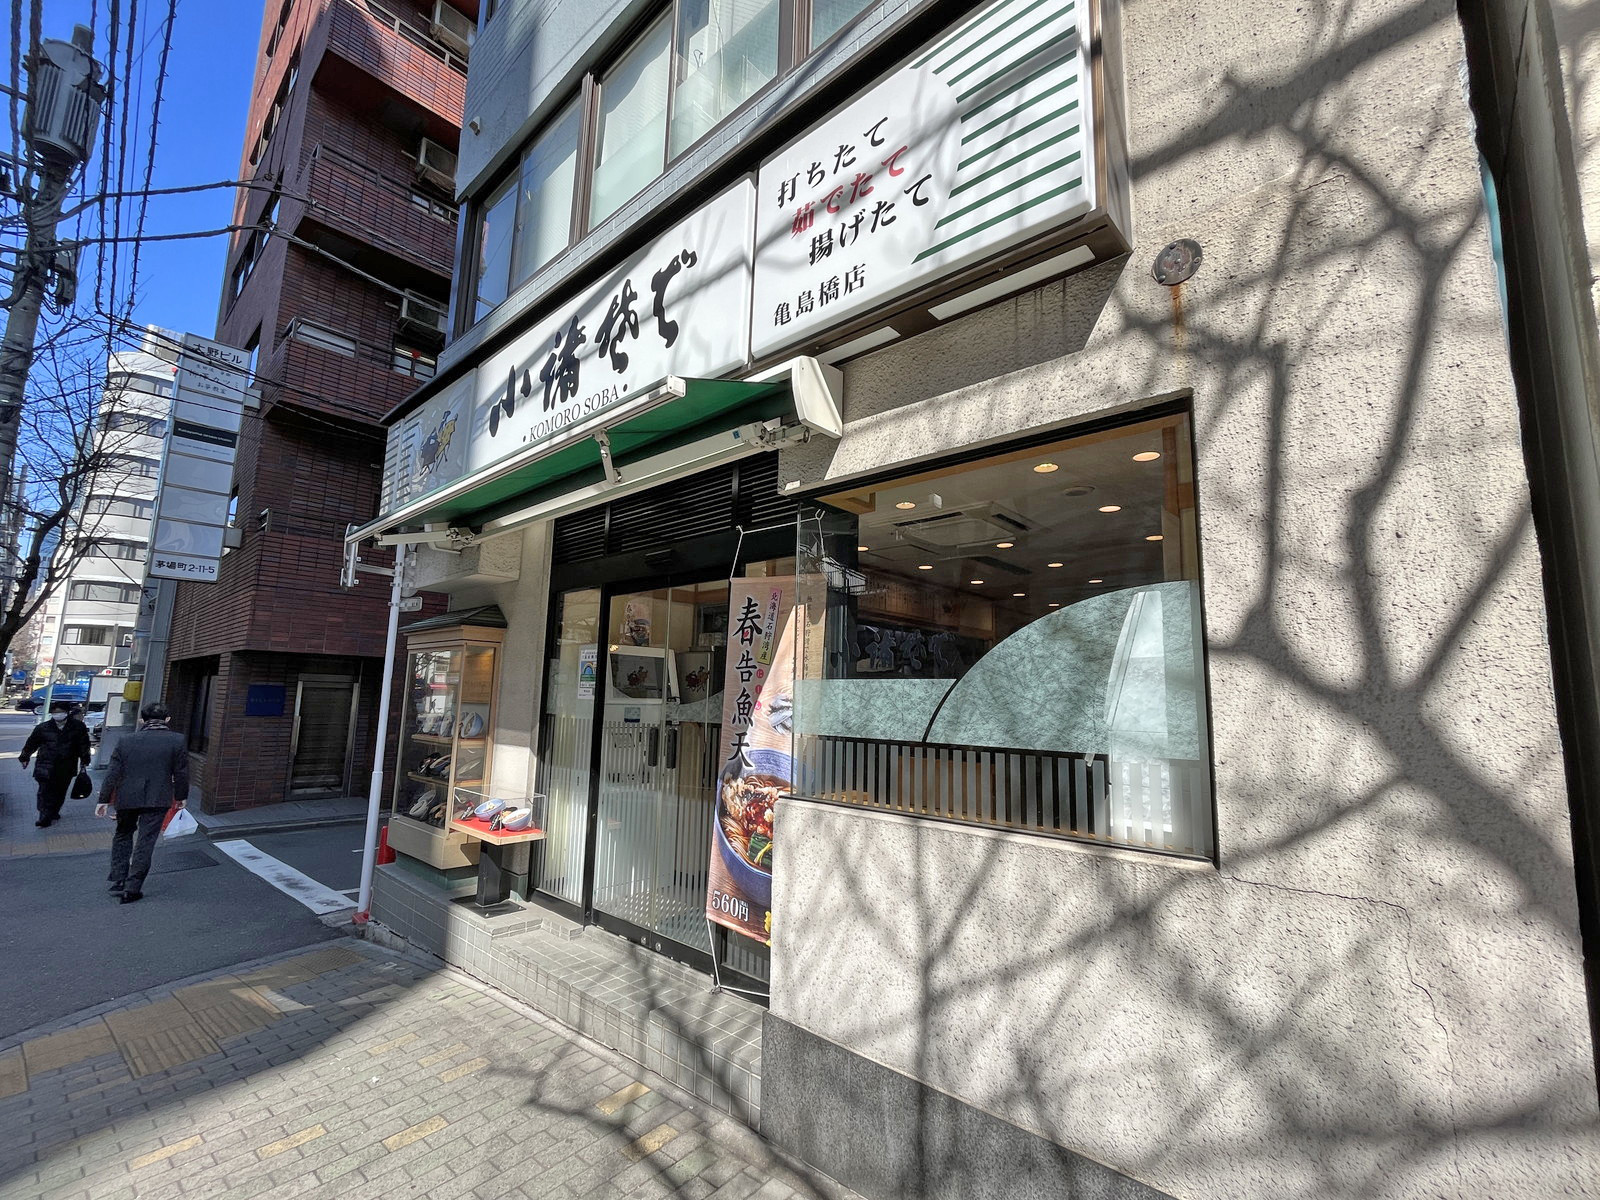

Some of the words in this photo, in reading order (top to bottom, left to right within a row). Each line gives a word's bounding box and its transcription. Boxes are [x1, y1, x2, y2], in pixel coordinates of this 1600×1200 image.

[777, 116, 889, 209] 打ちたて
[791, 145, 908, 240] 茹でたて
[809, 174, 932, 266] 揚げたて
[774, 263, 866, 327] 亀島橋店
[529, 403, 581, 442] KOMORO
[583, 384, 619, 416] SOBA
[155, 560, 215, 574] 茅場町2-11-5
[760, 591, 779, 661] 北海道石狩湾産
[728, 597, 763, 768] 春告魚天
[712, 890, 749, 922] 560円
